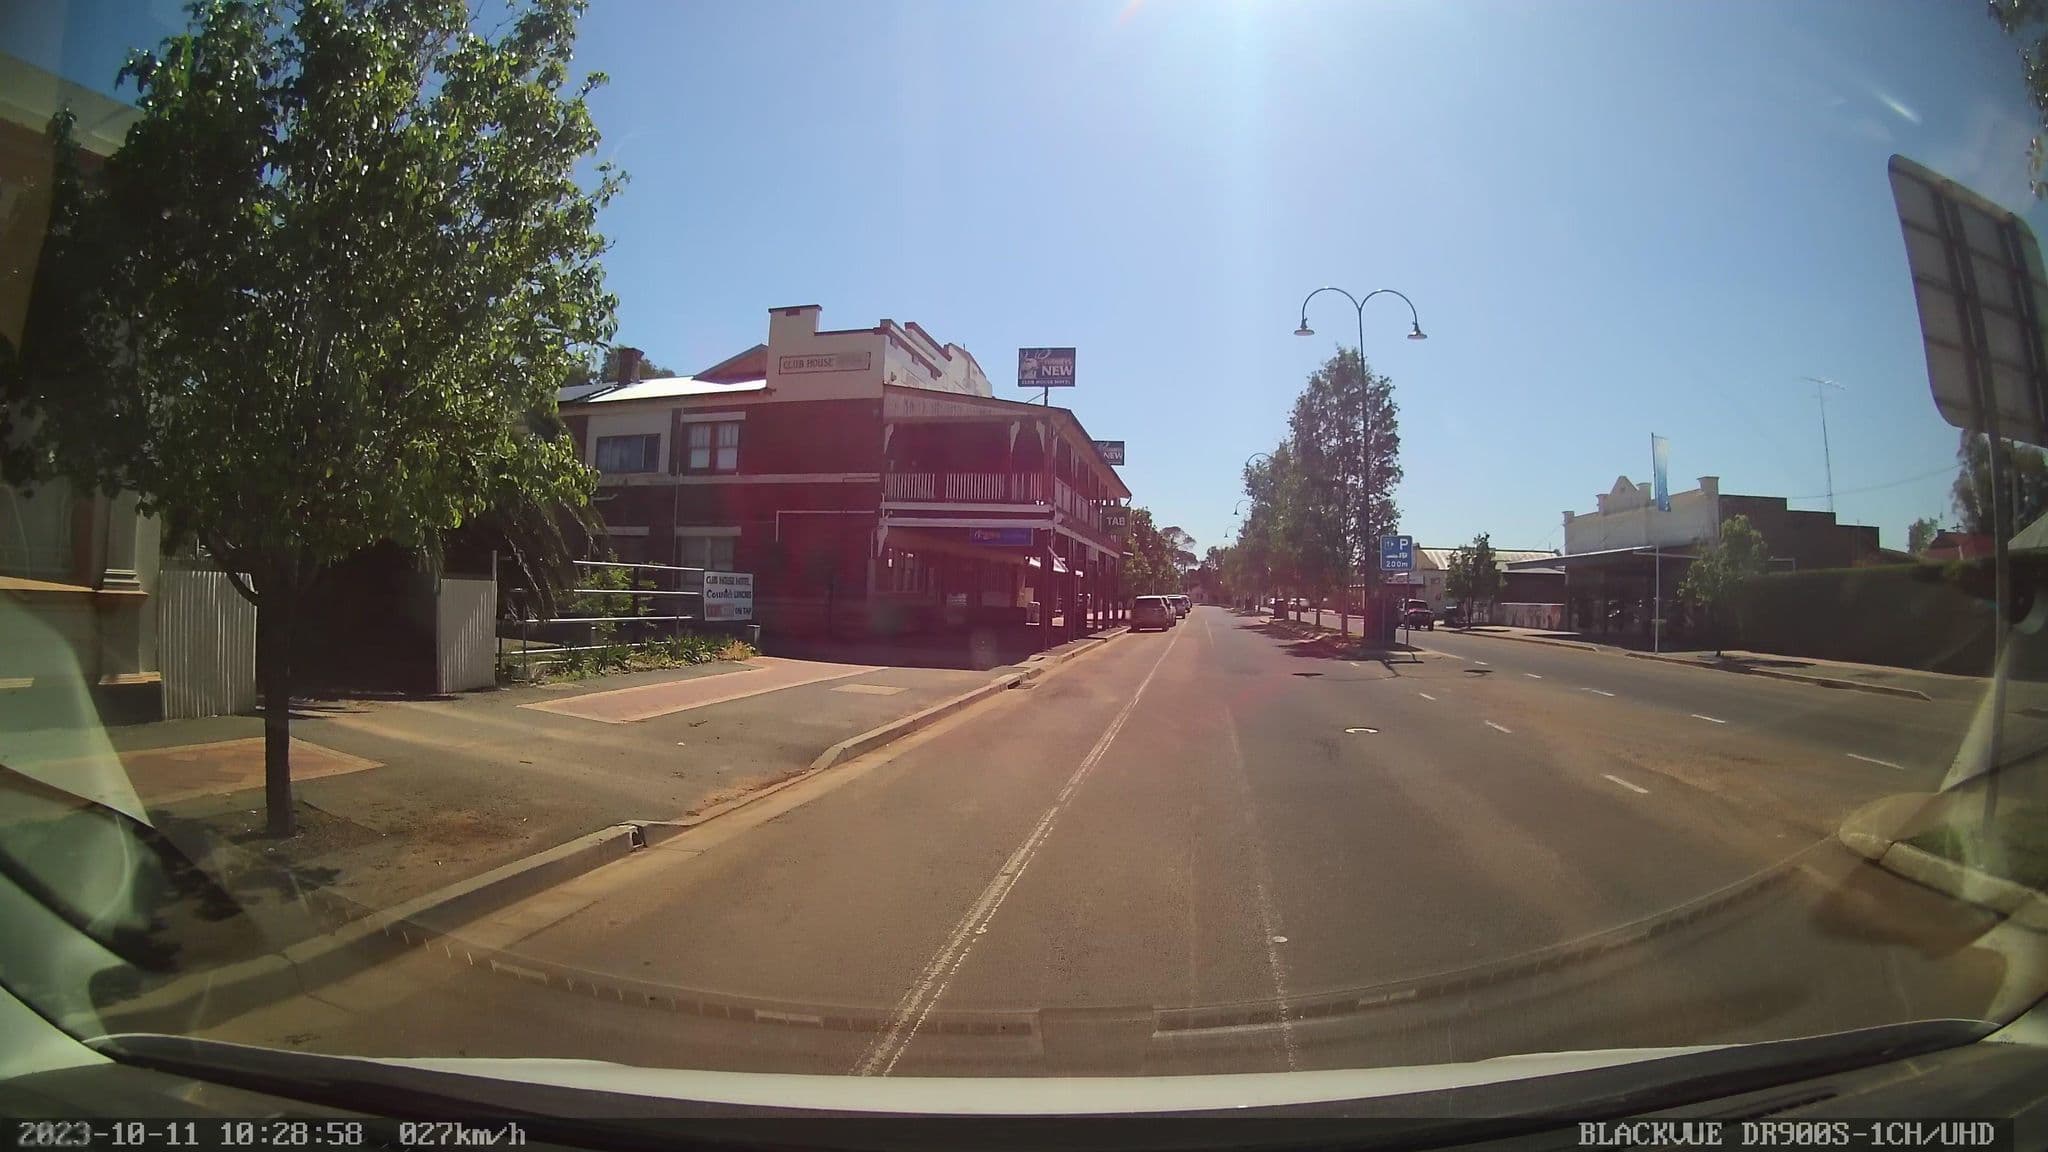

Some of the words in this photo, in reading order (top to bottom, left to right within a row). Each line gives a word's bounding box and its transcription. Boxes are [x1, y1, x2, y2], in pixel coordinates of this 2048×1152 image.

[783, 359, 805, 370] CLUB
[806, 357, 833, 369] HOUSE
[1042, 365, 1073, 377] NEW
[1106, 516, 1126, 526] TAB
[1399, 538, 1409, 551] P
[1386, 560, 1408, 568] 200m
